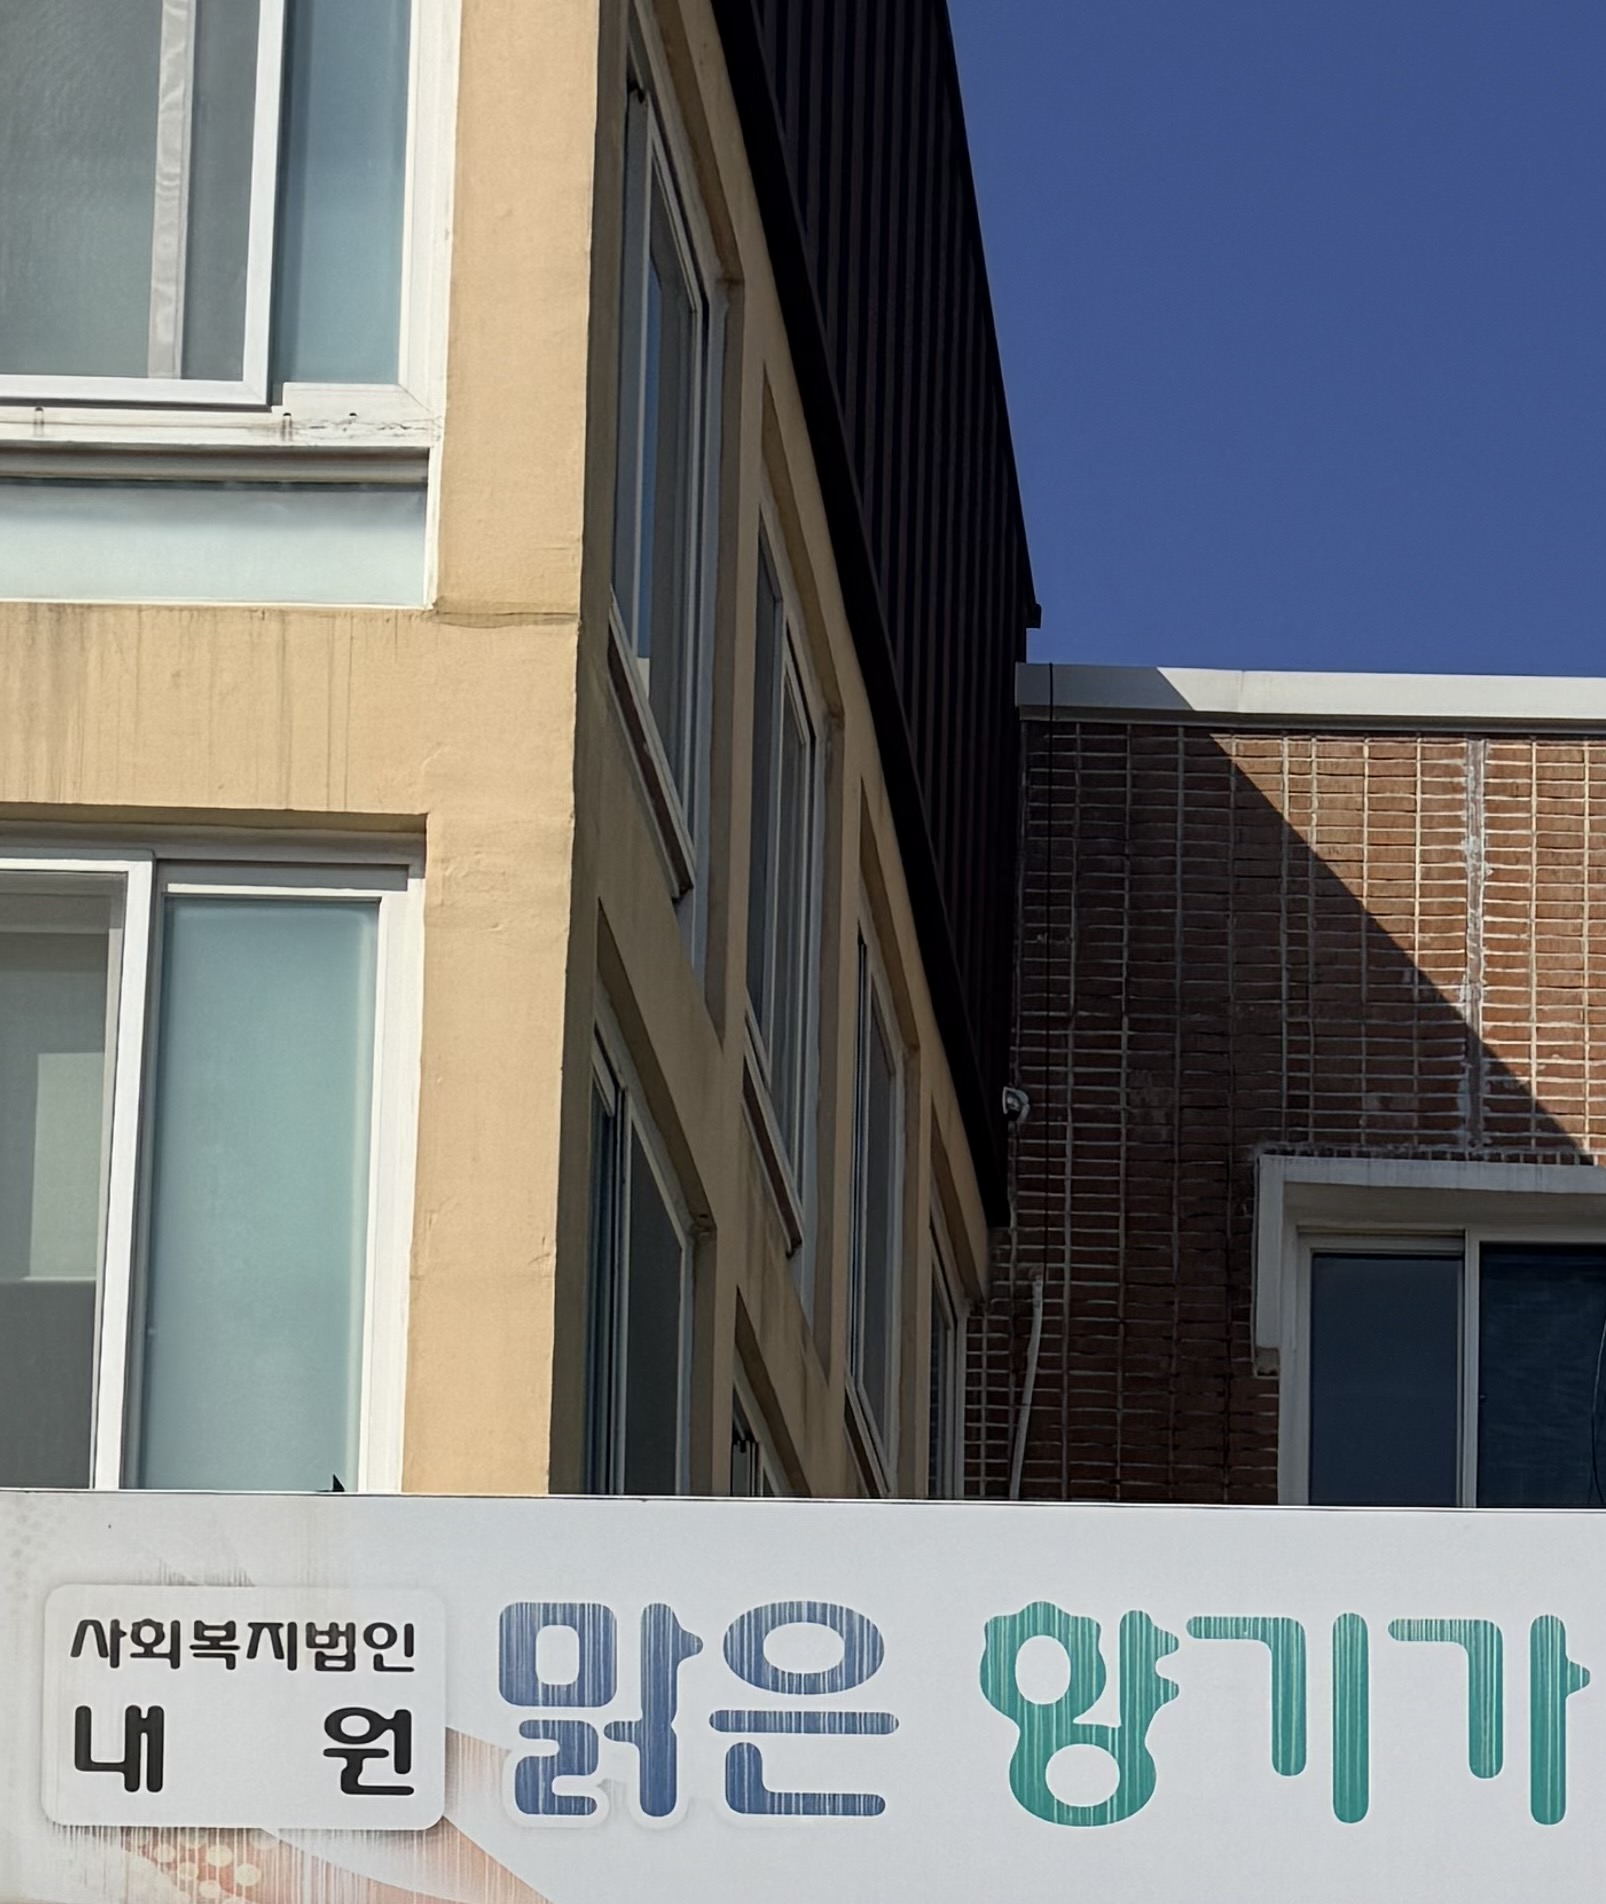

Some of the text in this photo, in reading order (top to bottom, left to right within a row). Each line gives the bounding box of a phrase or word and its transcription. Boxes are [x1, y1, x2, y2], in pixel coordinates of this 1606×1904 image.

[70, 1617, 415, 1673] 사회복지법인
[498, 1600, 899, 1818] 맑은
[979, 1600, 1591, 1828] 향기가
